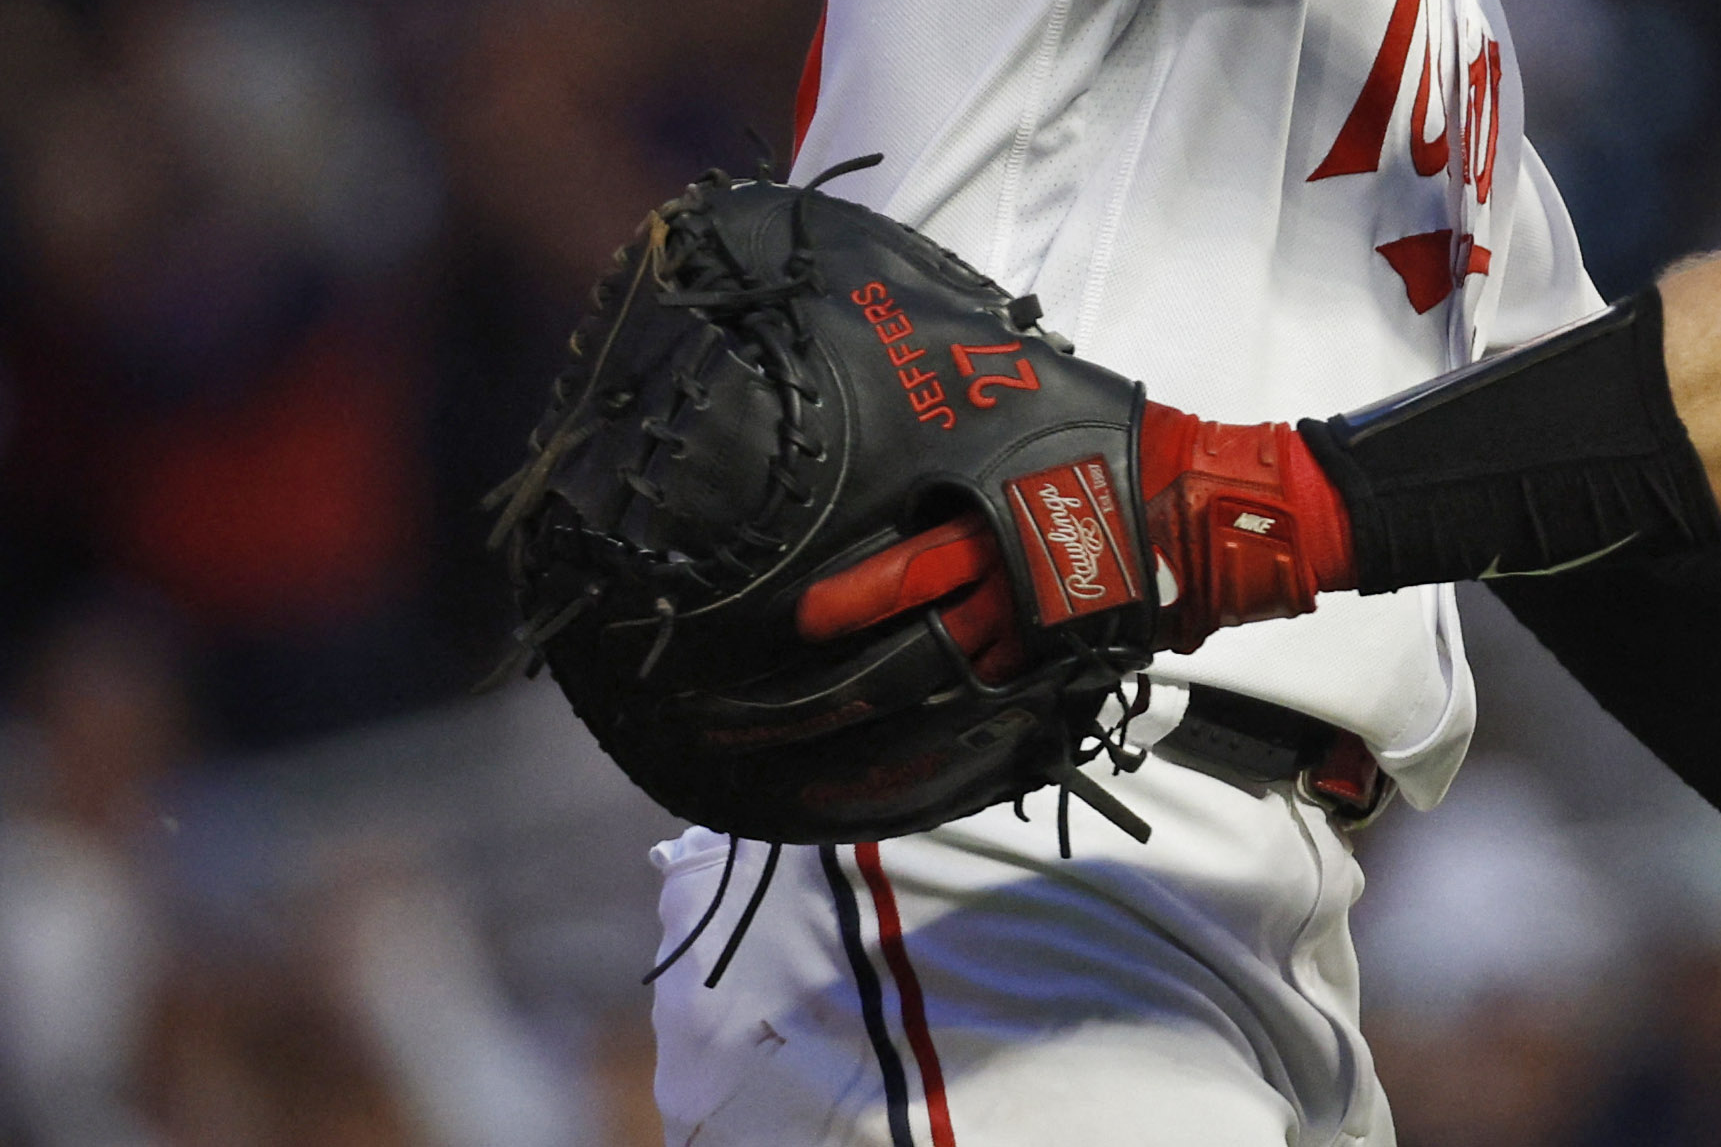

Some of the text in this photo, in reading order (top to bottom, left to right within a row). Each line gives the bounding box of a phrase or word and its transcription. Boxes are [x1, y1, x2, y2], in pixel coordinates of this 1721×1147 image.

[850, 280, 957, 430] JEFFERS
[949, 339, 1041, 409] 27
[1038, 483, 1106, 600] Rawlings
